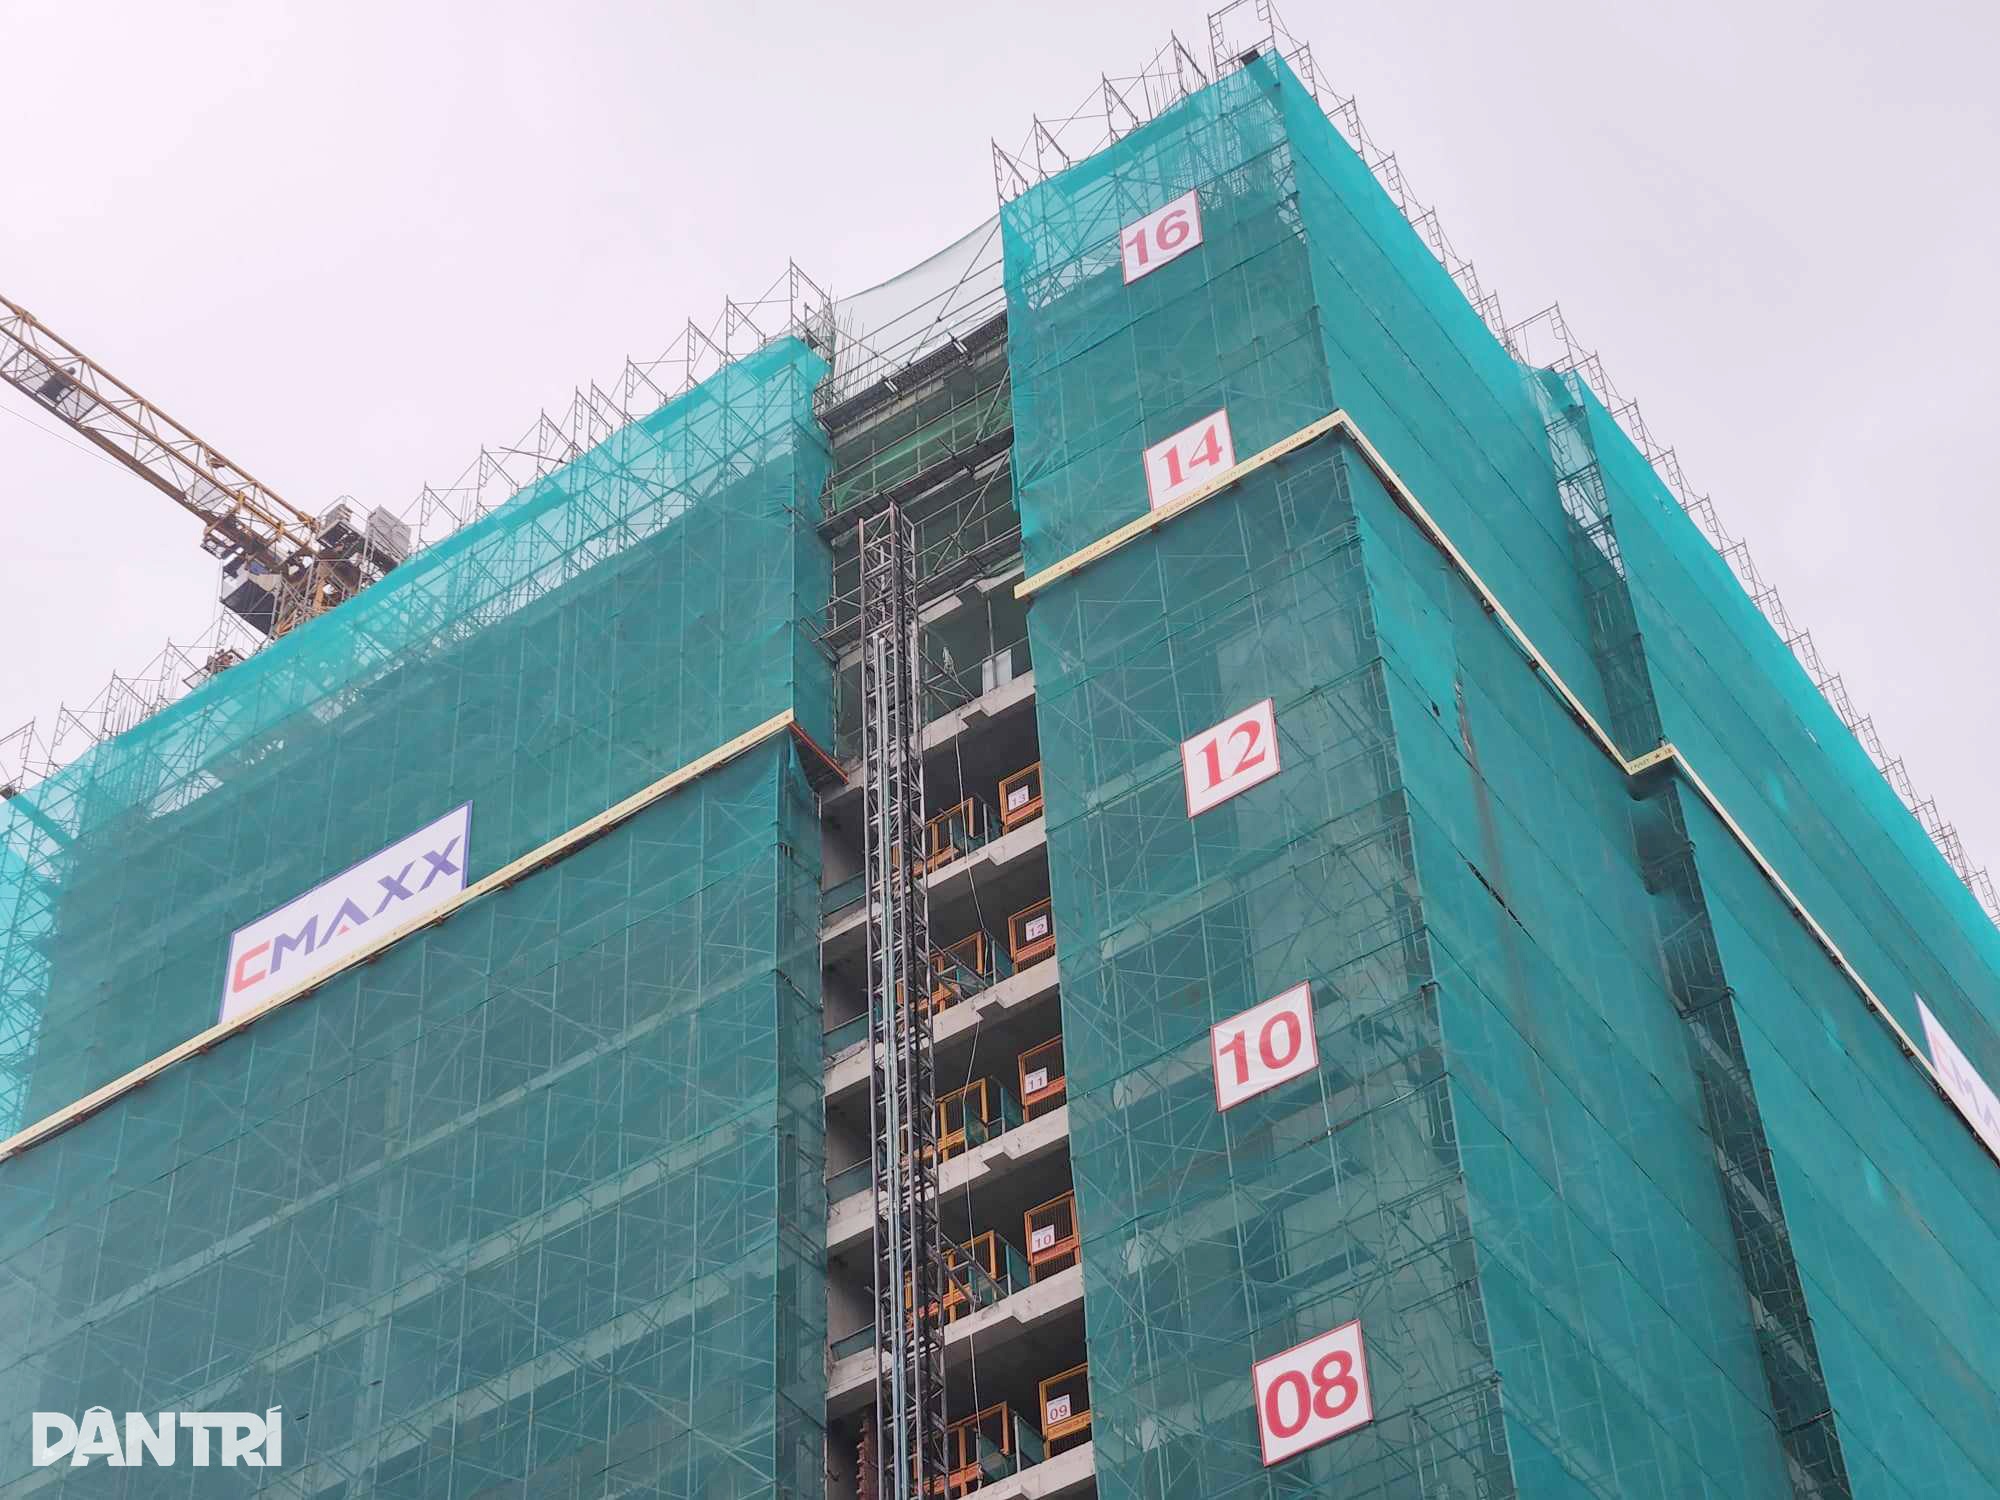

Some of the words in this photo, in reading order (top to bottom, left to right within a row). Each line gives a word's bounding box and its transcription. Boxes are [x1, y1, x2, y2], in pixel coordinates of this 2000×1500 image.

[1125, 209, 1190, 267] 16
[1160, 424, 1223, 491] 14
[1196, 719, 1266, 793] 12
[232, 834, 462, 993] CMAXX
[1029, 923, 1046, 937] 12
[1219, 1010, 1302, 1086] 10
[1029, 1076, 1043, 1090] 11
[1035, 1234, 1052, 1249] 10
[1050, 1404, 1068, 1421] 09
[1265, 1350, 1359, 1439] 08
